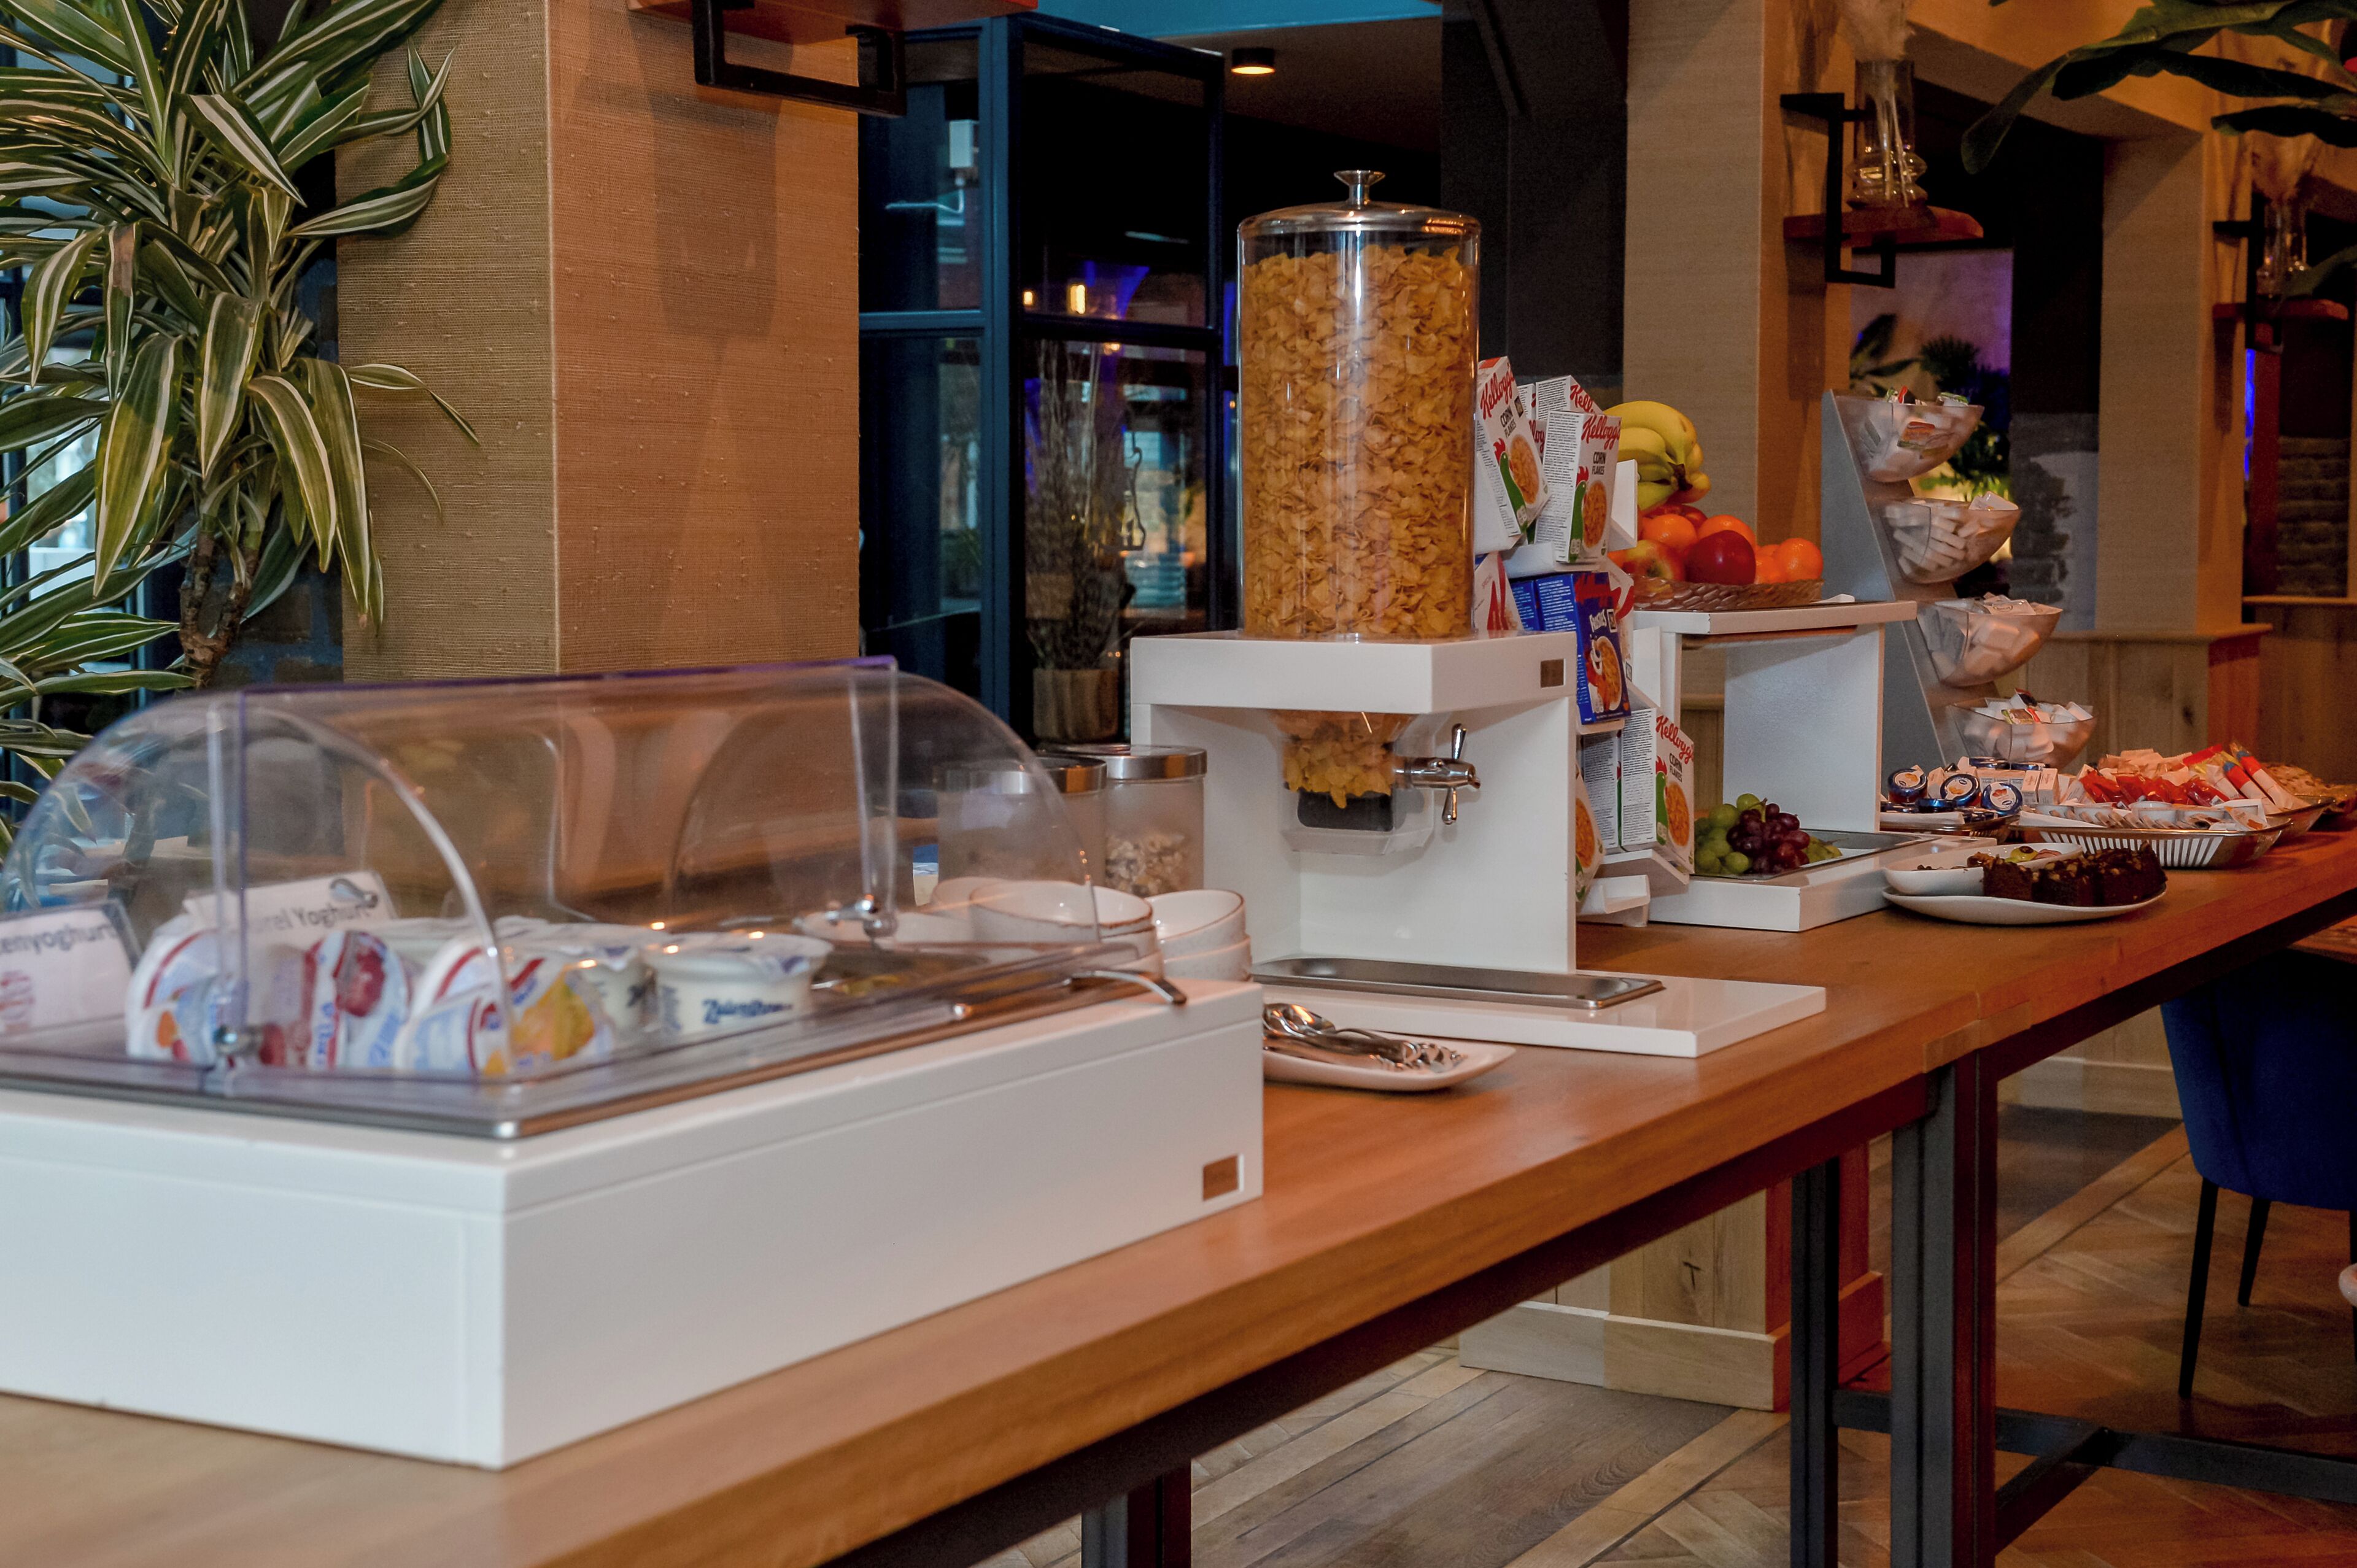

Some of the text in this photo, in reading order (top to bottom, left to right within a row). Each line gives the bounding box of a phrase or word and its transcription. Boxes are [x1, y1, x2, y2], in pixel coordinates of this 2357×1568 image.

[1569, 384, 1595, 412] Kell
[1500, 405, 1514, 428] CORN
[1593, 451, 1606, 464] CORN
[1592, 466, 1605, 475] FLAKES
[1669, 752, 1682, 774] CORN
